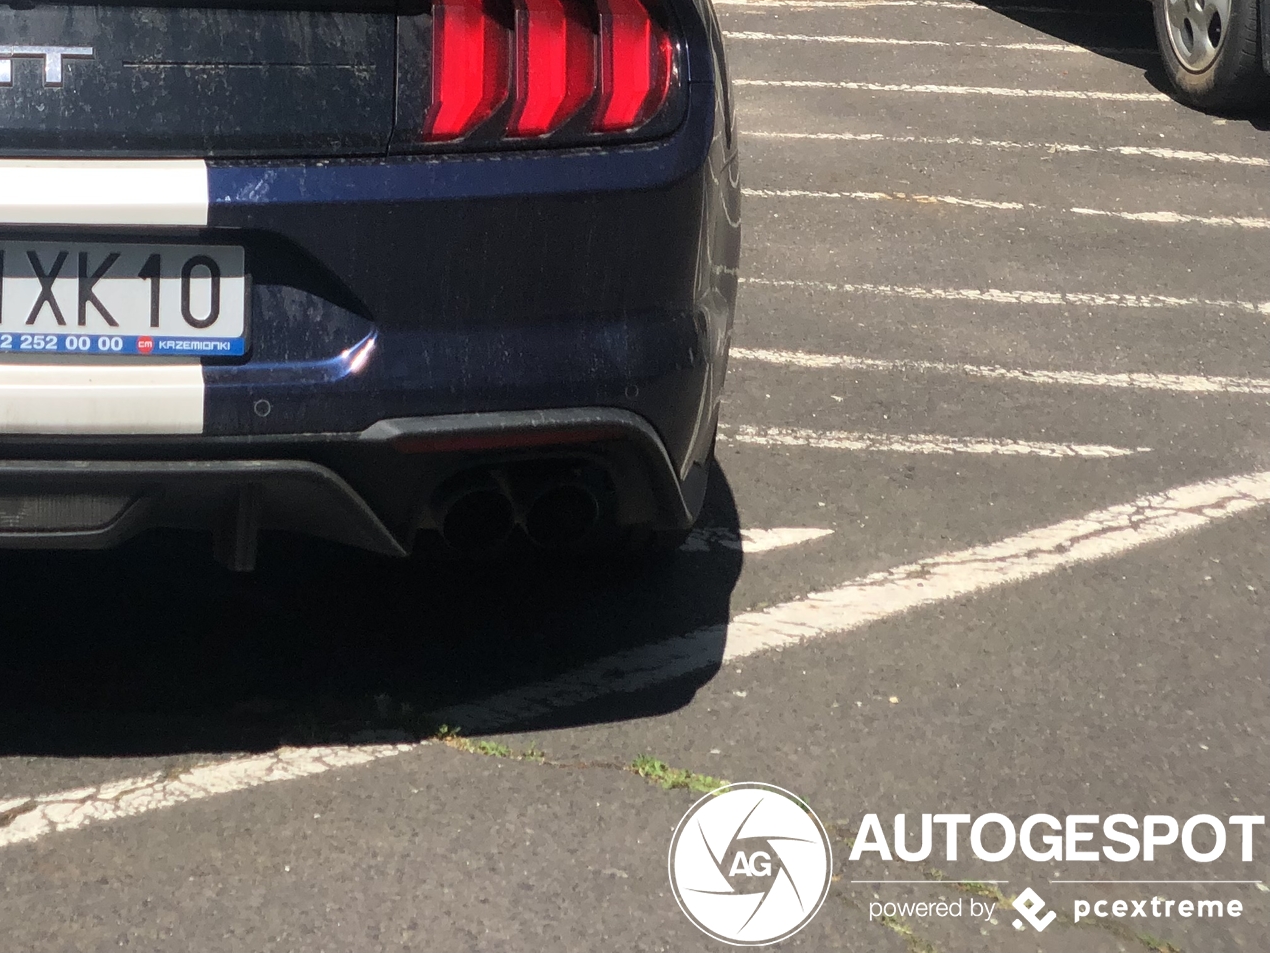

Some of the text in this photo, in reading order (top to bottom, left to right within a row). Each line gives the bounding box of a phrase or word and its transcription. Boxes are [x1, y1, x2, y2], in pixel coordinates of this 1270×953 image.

[20, 335, 57, 349] 252
[65, 336, 90, 350] 00
[98, 336, 123, 351] 00
[159, 341, 231, 351] KRZEMIONKI
